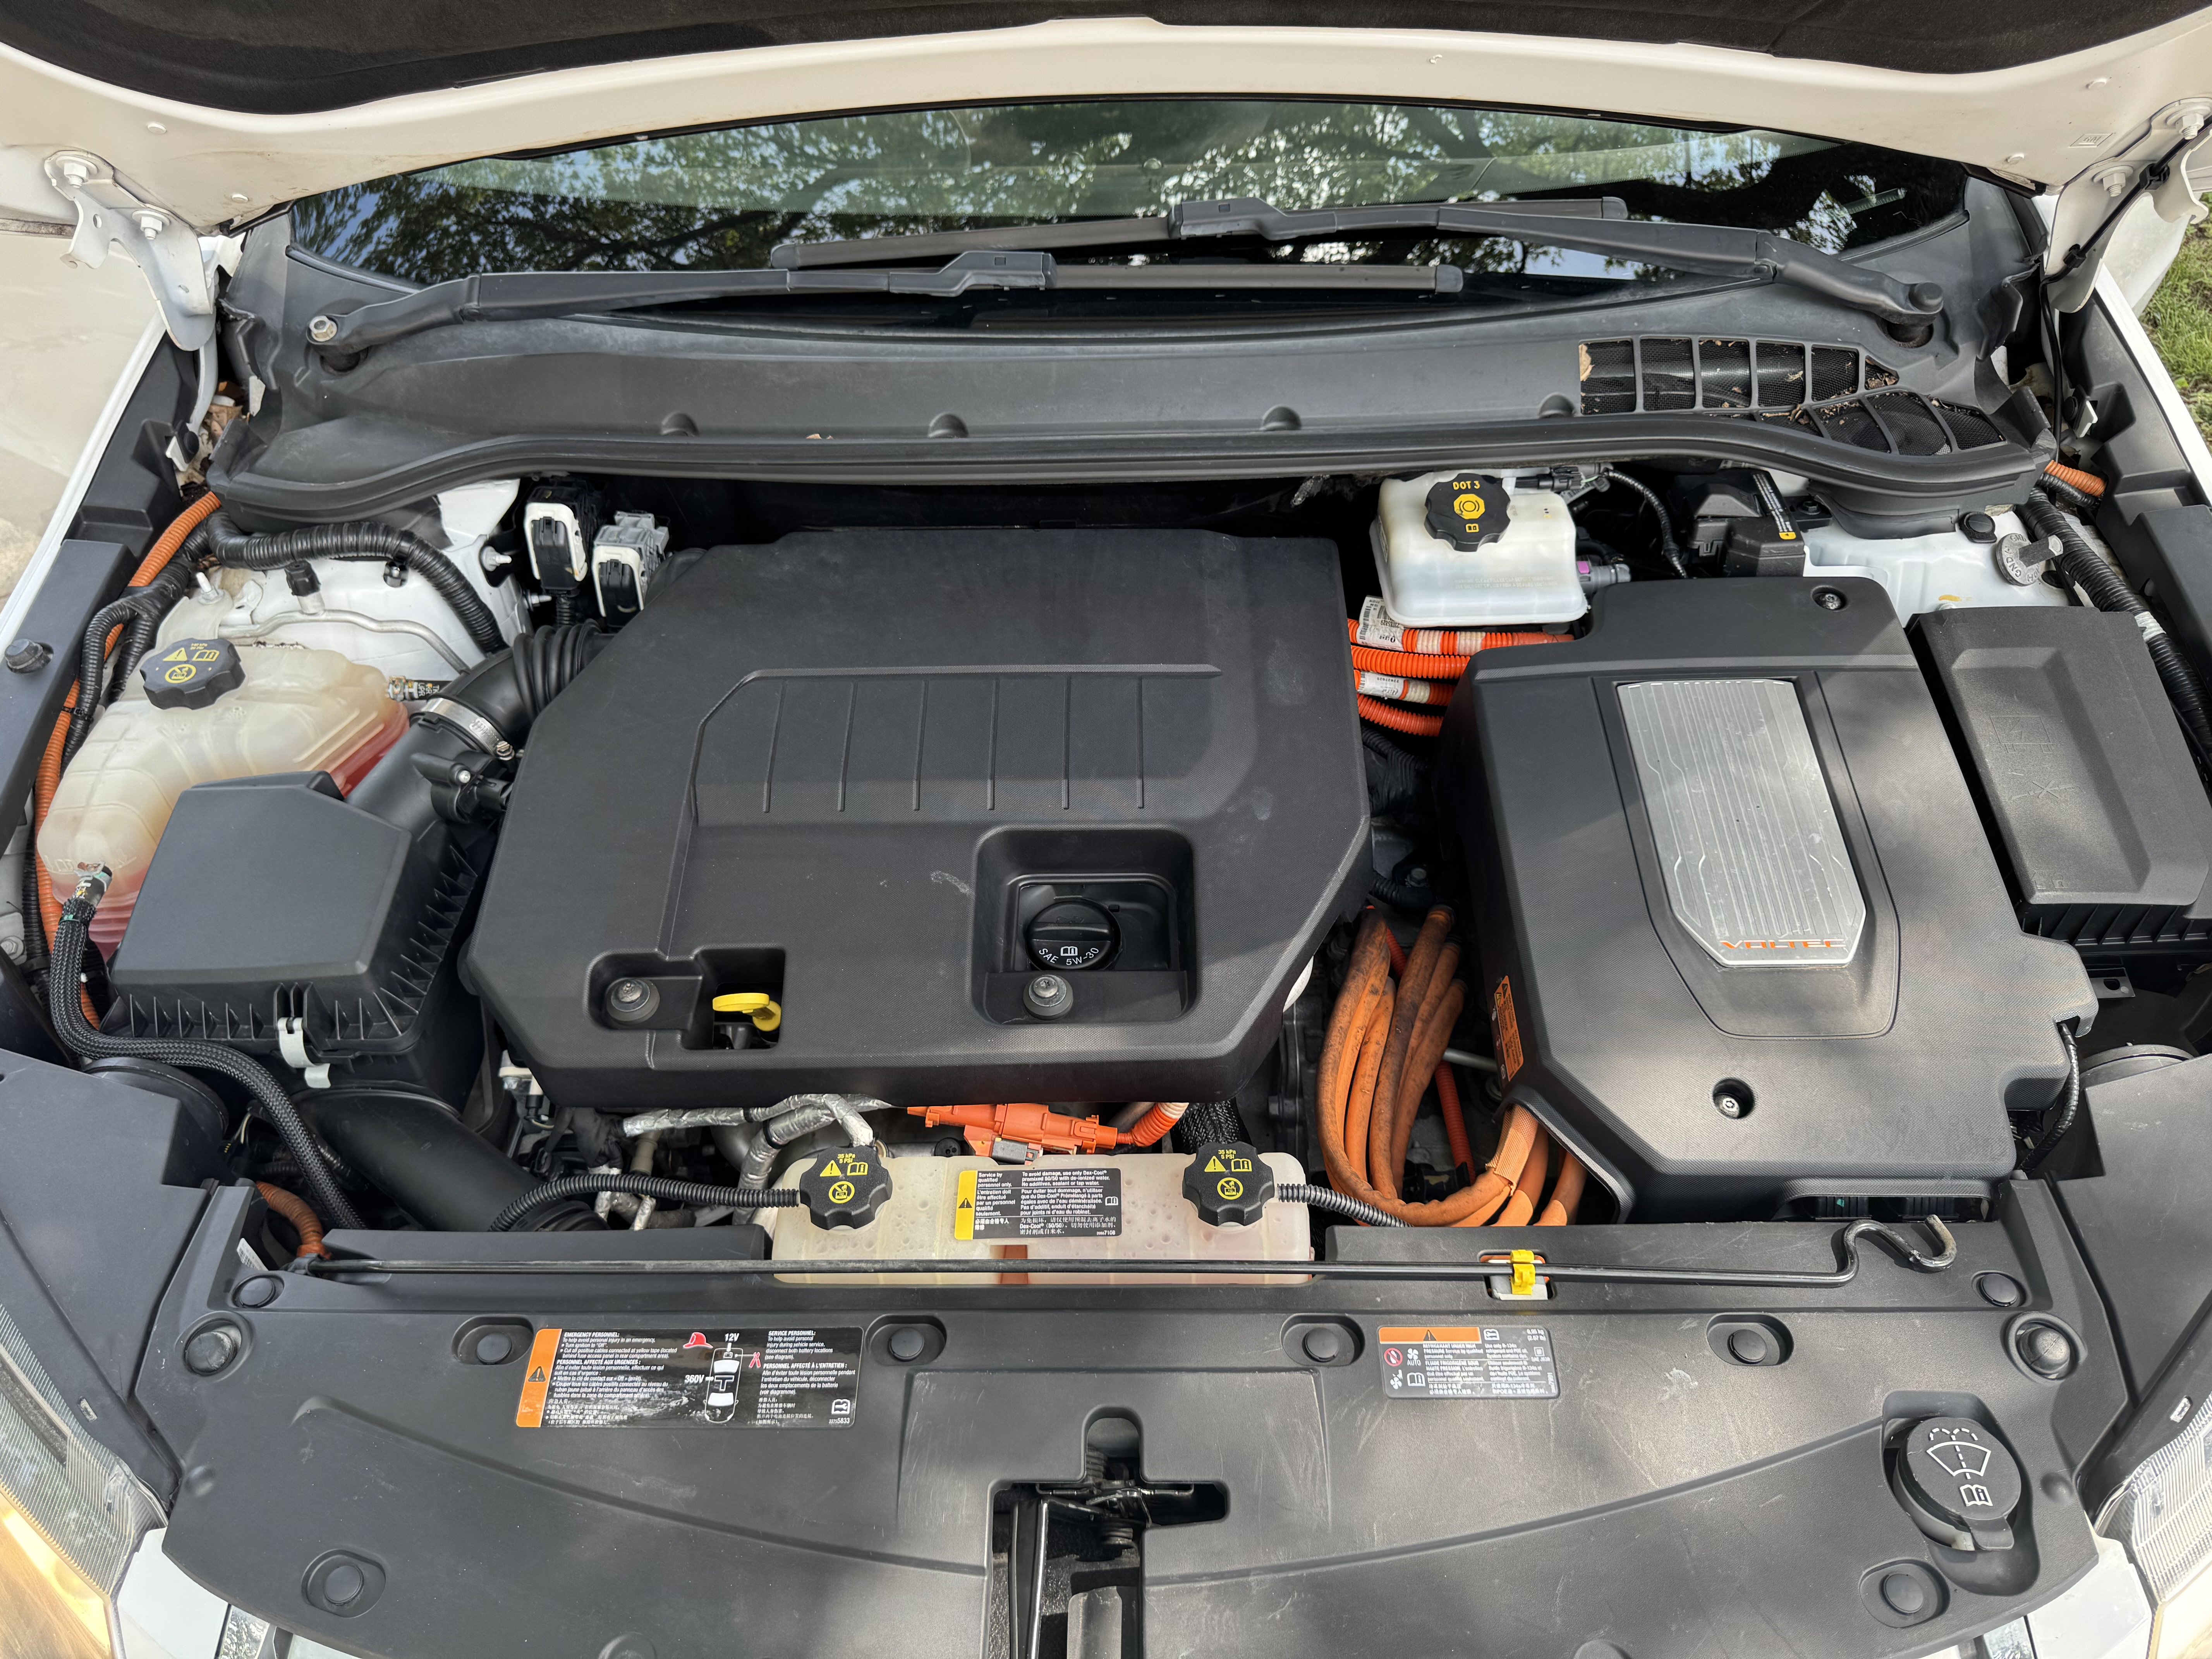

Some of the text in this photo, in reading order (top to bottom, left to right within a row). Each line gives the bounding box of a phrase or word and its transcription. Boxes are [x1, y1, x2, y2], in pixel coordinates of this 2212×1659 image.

[1453, 481, 1480, 490] DOT 3
[2006, 557, 2021, 577] GND
[1719, 939, 1846, 949] VOLTEC
[1039, 948, 1099, 965] SAE 5W-30
[725, 1333, 739, 1341] 12V
[684, 1374, 704, 1384] 360V
